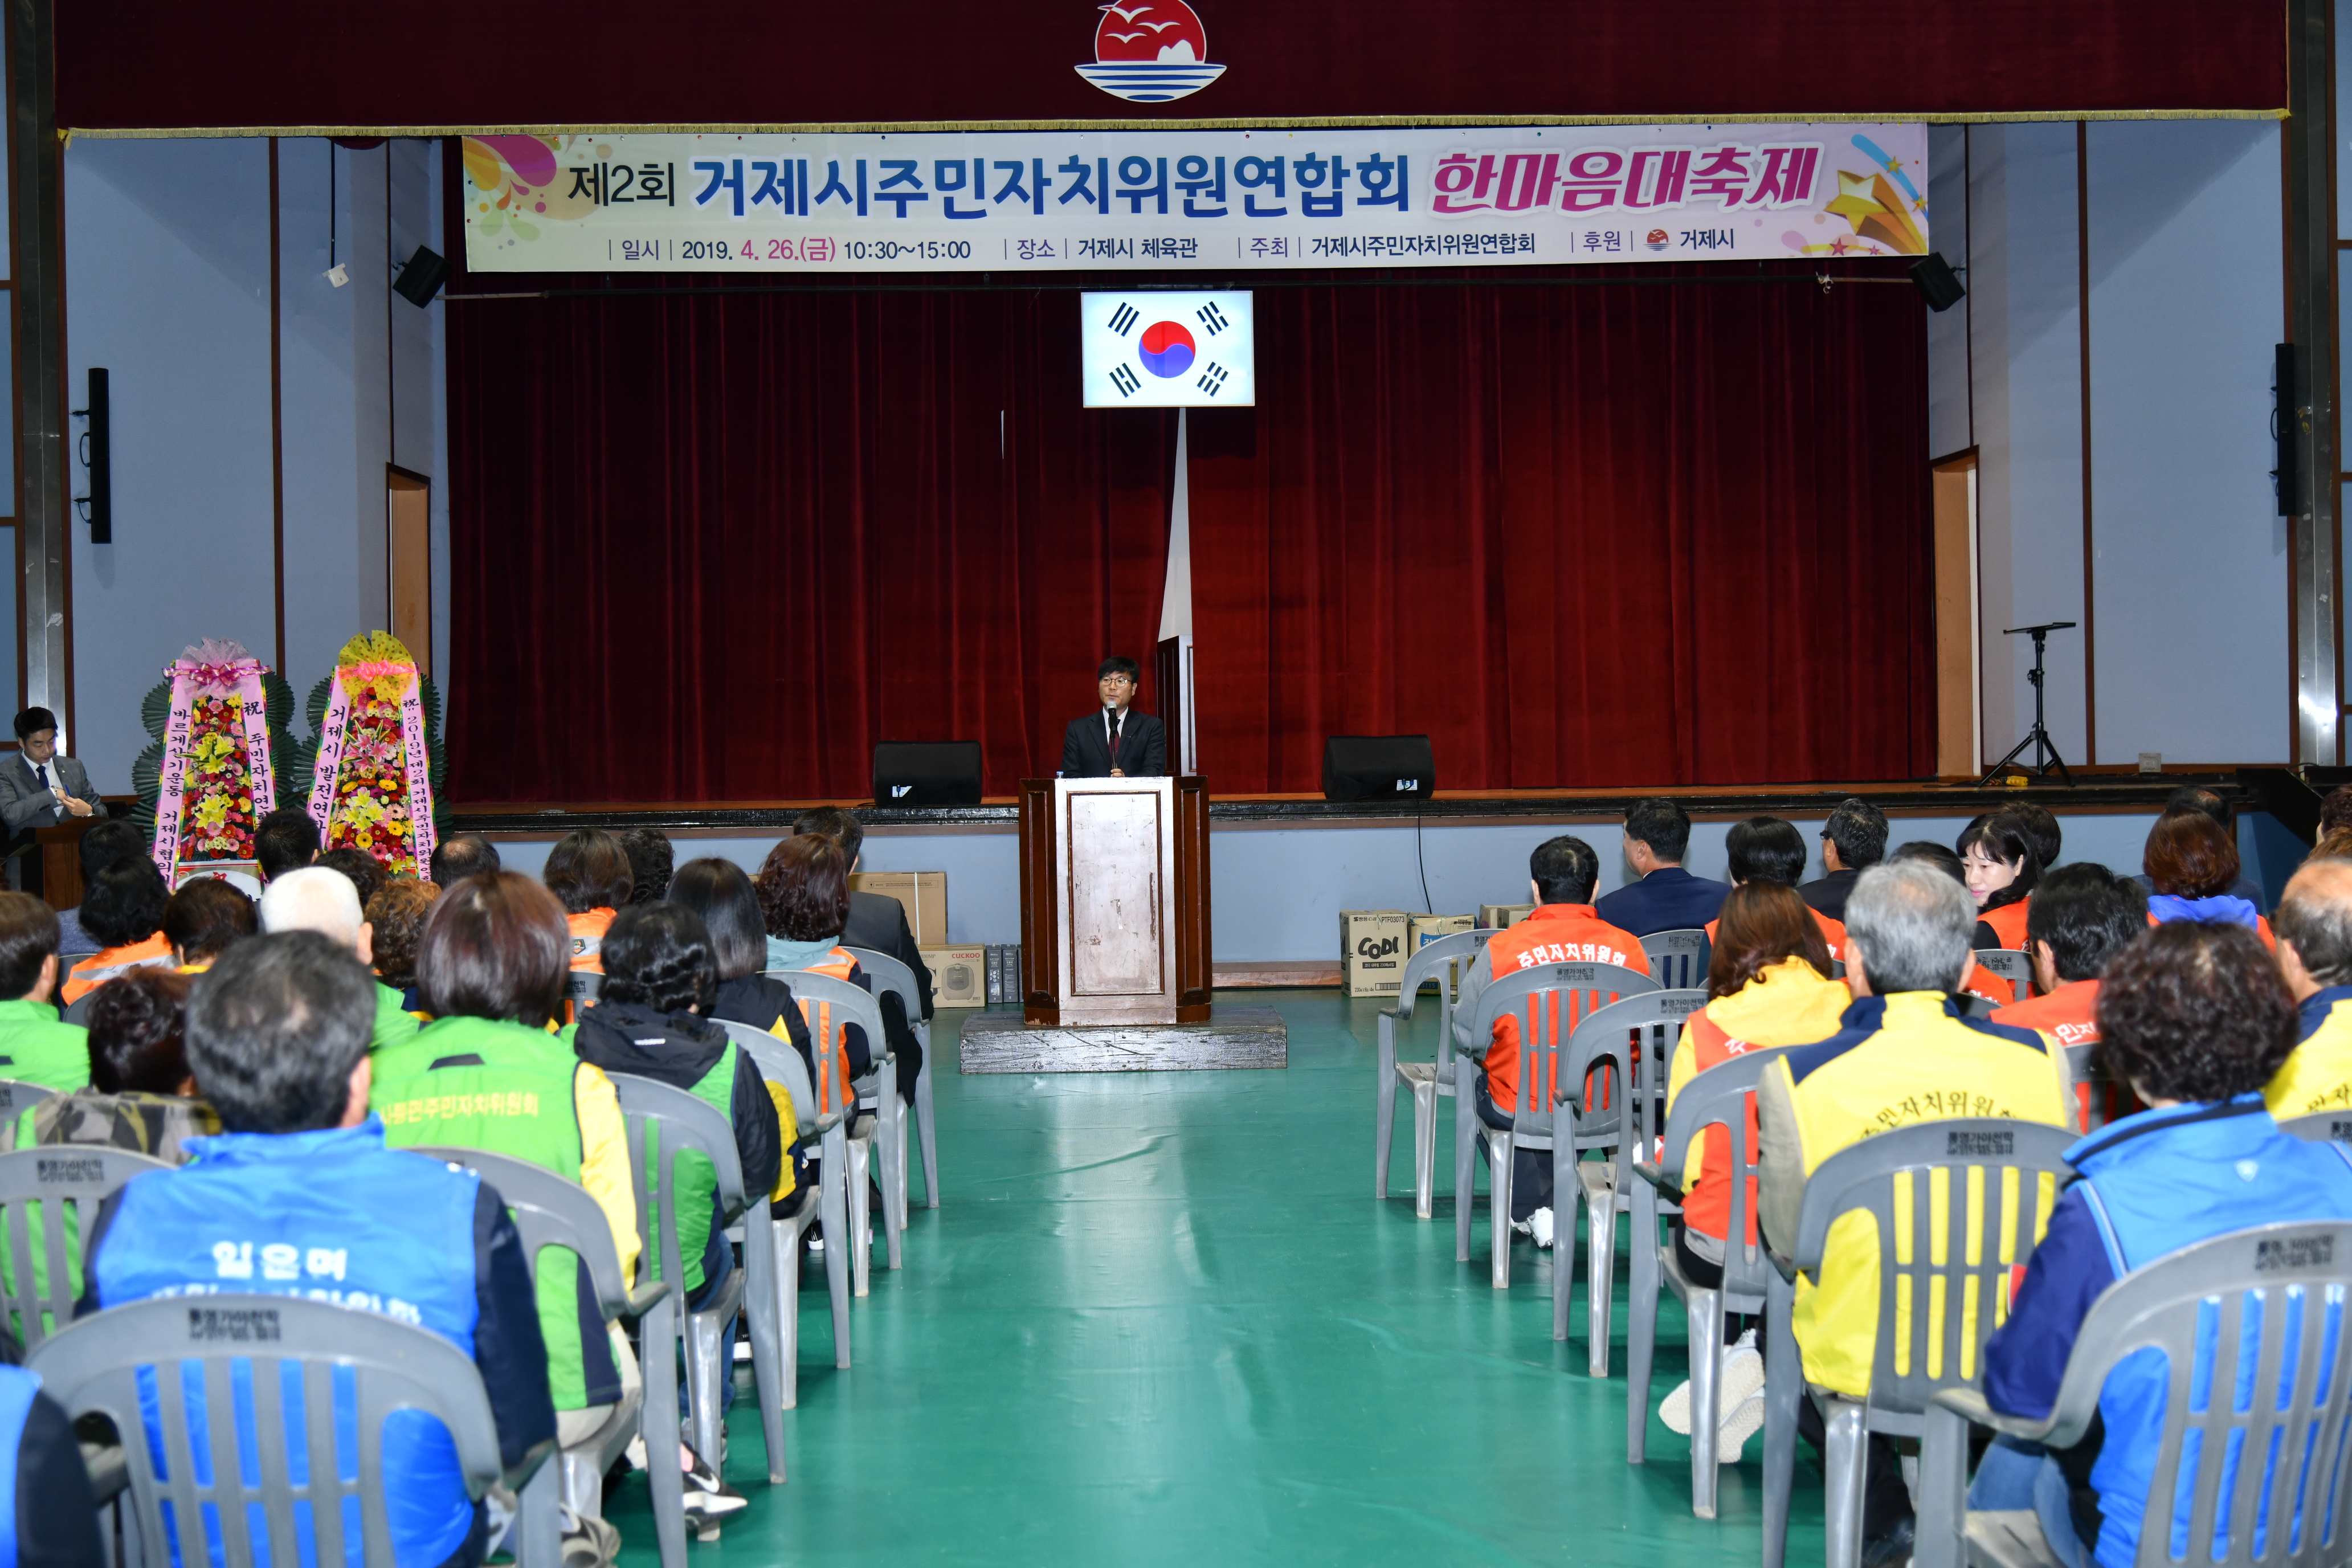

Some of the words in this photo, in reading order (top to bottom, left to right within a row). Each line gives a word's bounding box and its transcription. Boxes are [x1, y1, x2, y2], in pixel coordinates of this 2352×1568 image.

[567, 161, 676, 207] 제2회
[693, 152, 1409, 220] 거제시주민자치위원연합회
[1432, 146, 1819, 215] 한마음대축제
[622, 239, 660, 261] 일시
[682, 240, 733, 260] 2019.
[740, 240, 758, 260] 4.
[767, 236, 836, 263] 26.(금)
[844, 240, 971, 260] 10:30~15:00
[1016, 238, 1056, 260] 장소
[1078, 237, 1134, 259] 거제시
[1141, 237, 1198, 259] 체육관
[1251, 236, 1289, 258] 주최
[1312, 232, 1535, 258] 거제시주민자치위원연합회
[1583, 230, 1621, 252] 후원
[1680, 228, 1735, 251] 거제시
[243, 701, 263, 716] 祝
[322, 705, 346, 758] 거제시
[1358, 936, 1399, 959] CODI
[1517, 943, 1627, 967] 주민자치위원회
[1860, 1091, 2017, 1140] 민자치위원
